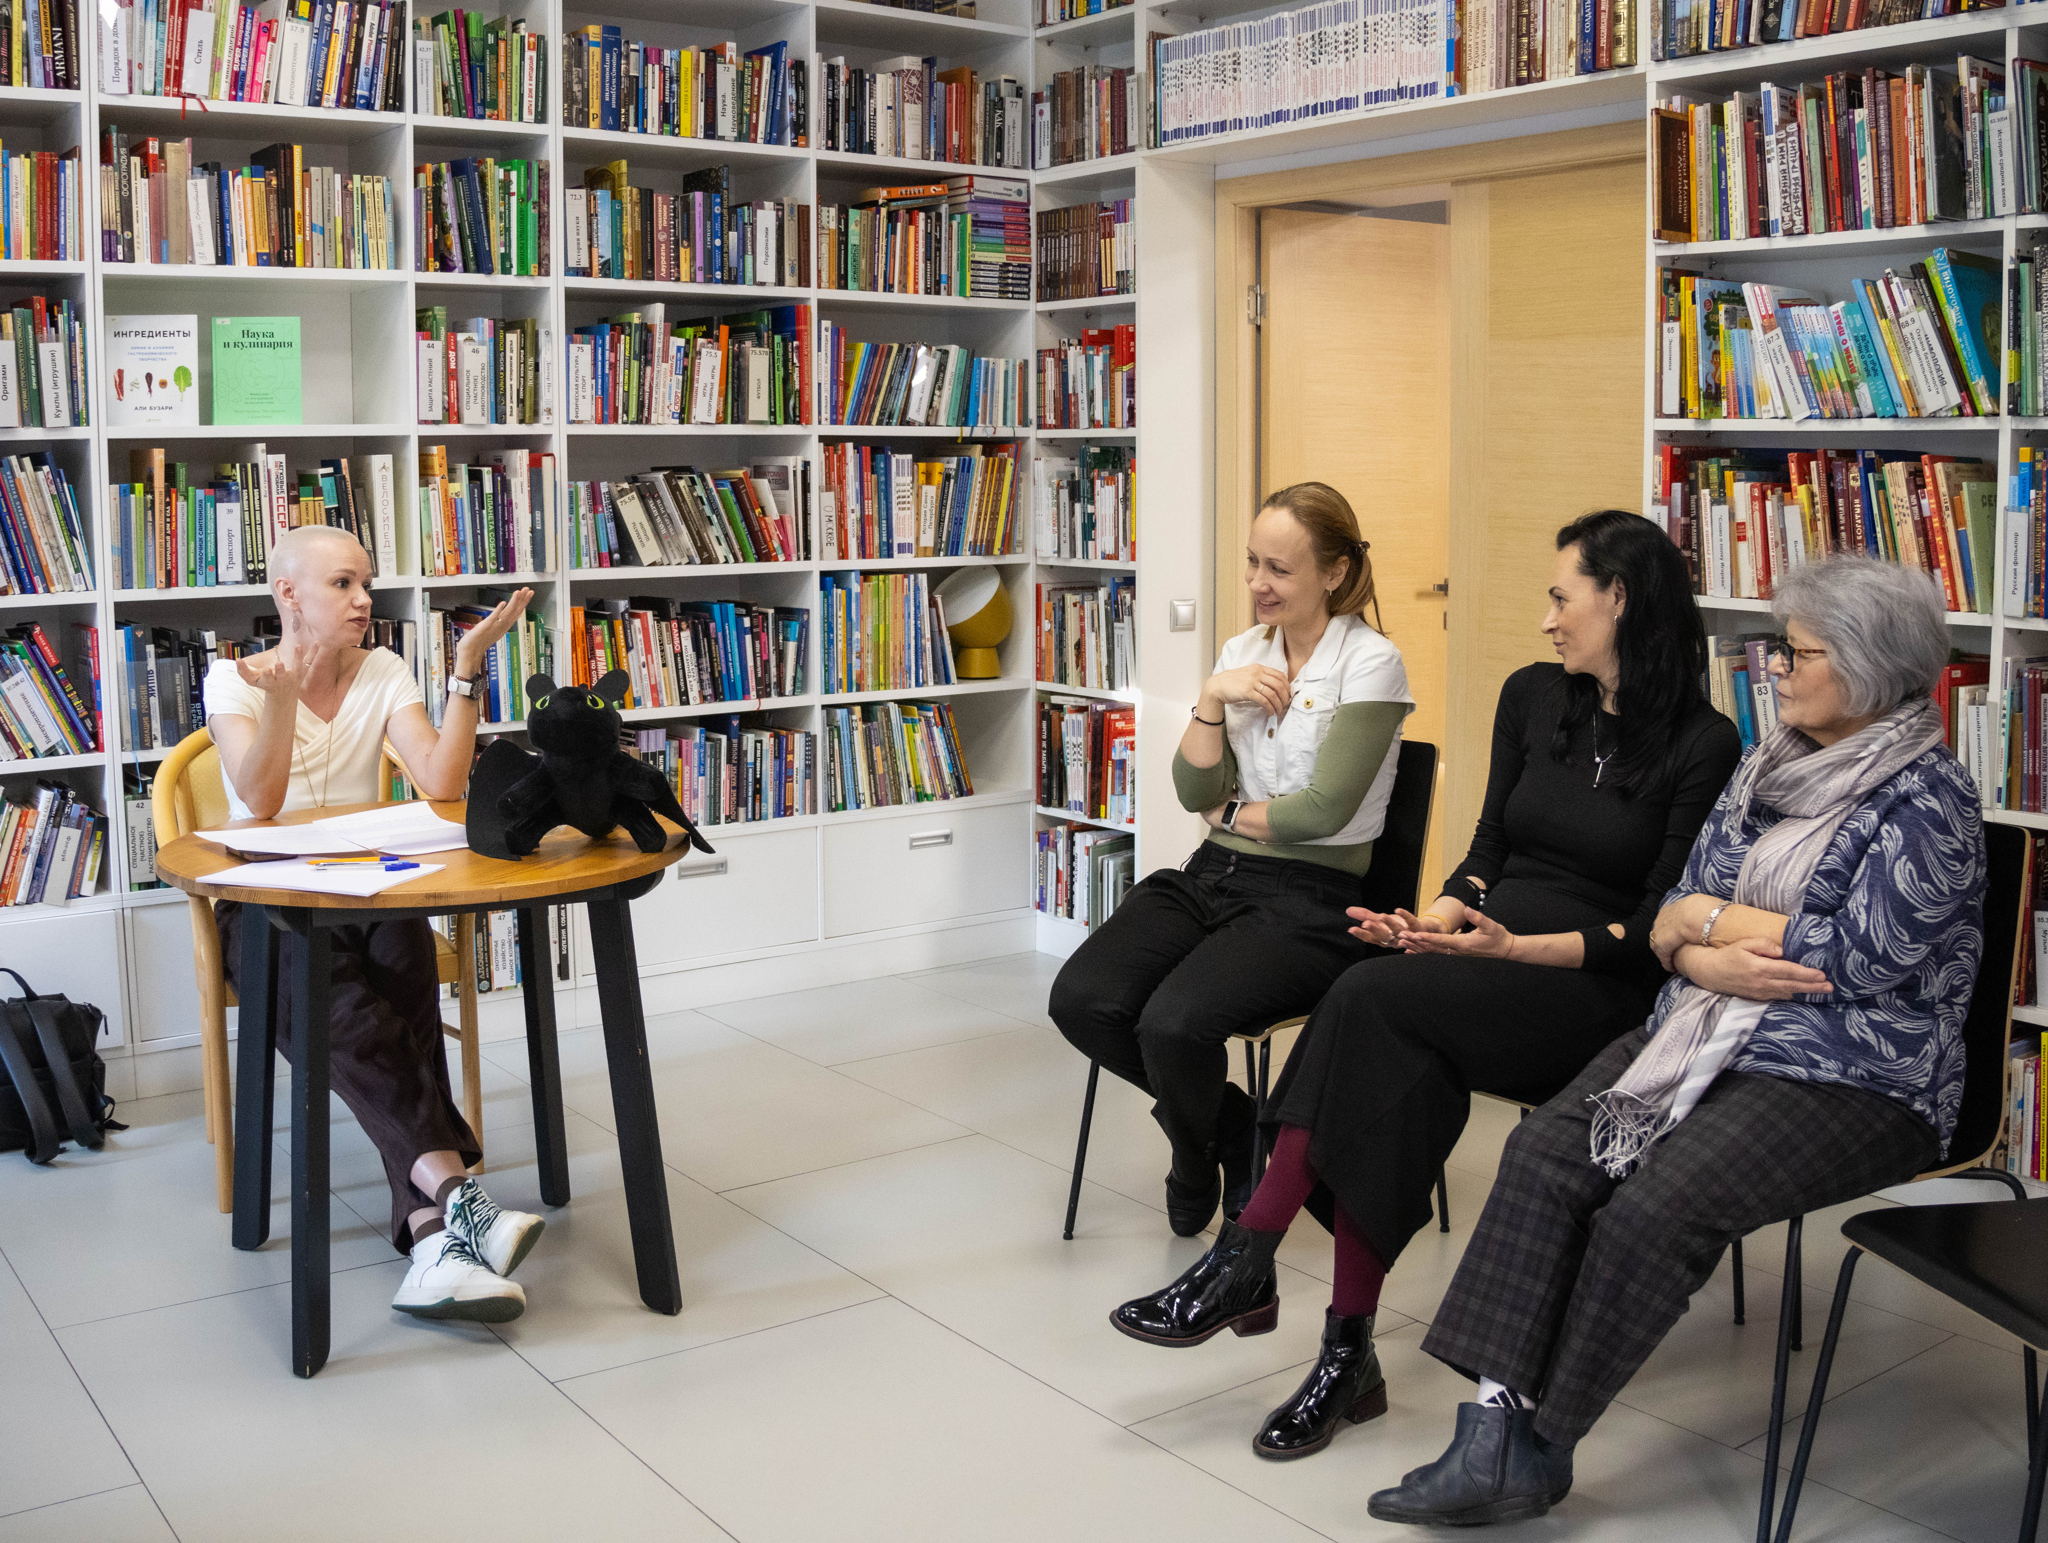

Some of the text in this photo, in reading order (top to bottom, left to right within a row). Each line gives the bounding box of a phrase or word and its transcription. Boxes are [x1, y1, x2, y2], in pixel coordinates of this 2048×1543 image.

[367, 22, 375, 38] Adobe
[53, 27, 66, 79] ARMANI
[194, 39, 203, 64] Стиль
[233, 48, 242, 71] SUPER
[240, 48, 248, 71] SUPER
[318, 47, 327, 79] Photoshop
[364, 39, 373, 66] Photoshop
[112, 52, 121, 83] Порядок
[1997, 129, 2005, 157] История
[120, 148, 129, 197] ФОТОГРАФИЯ
[1779, 146, 1791, 213] ДРЕВНИЙ РИМ
[1788, 139, 1802, 217] ДРЕВНЯЯ ГРЕЦИЯ
[114, 330, 191, 338] ИНГРЕДИЕНТЫ
[232, 340, 293, 350] кулинария
[241, 330, 274, 339] Наука
[1771, 348, 1781, 365] науки
[1775, 345, 1785, 362] Право
[1842, 347, 1857, 374] ДЕТЯМ
[1916, 329, 1926, 351] Охрана
[1922, 352, 1940, 395] безопасности
[1, 365, 9, 401] Оригами
[49, 350, 61, 418] Куклы (игрушки)
[277, 496, 286, 529] СССР
[382, 474, 390, 549] ВЕЛОСИПЕД
[488, 531, 496, 558] СОБАК
[632, 522, 647, 549] ШАХМАТЫ
[639, 521, 650, 541] ШАШКИ
[226, 528, 235, 570] Транспорт
[2011, 570, 2019, 595] Русский
[672, 622, 680, 651] САМБО
[147, 669, 156, 698] ЯЩИК
[1756, 686, 1768, 695] 83
[19, 693, 52, 744] Бисероплетение
[140, 685, 150, 747] АВИАЦИЯ РОССИИ
[1976, 733, 1984, 778] литературная
